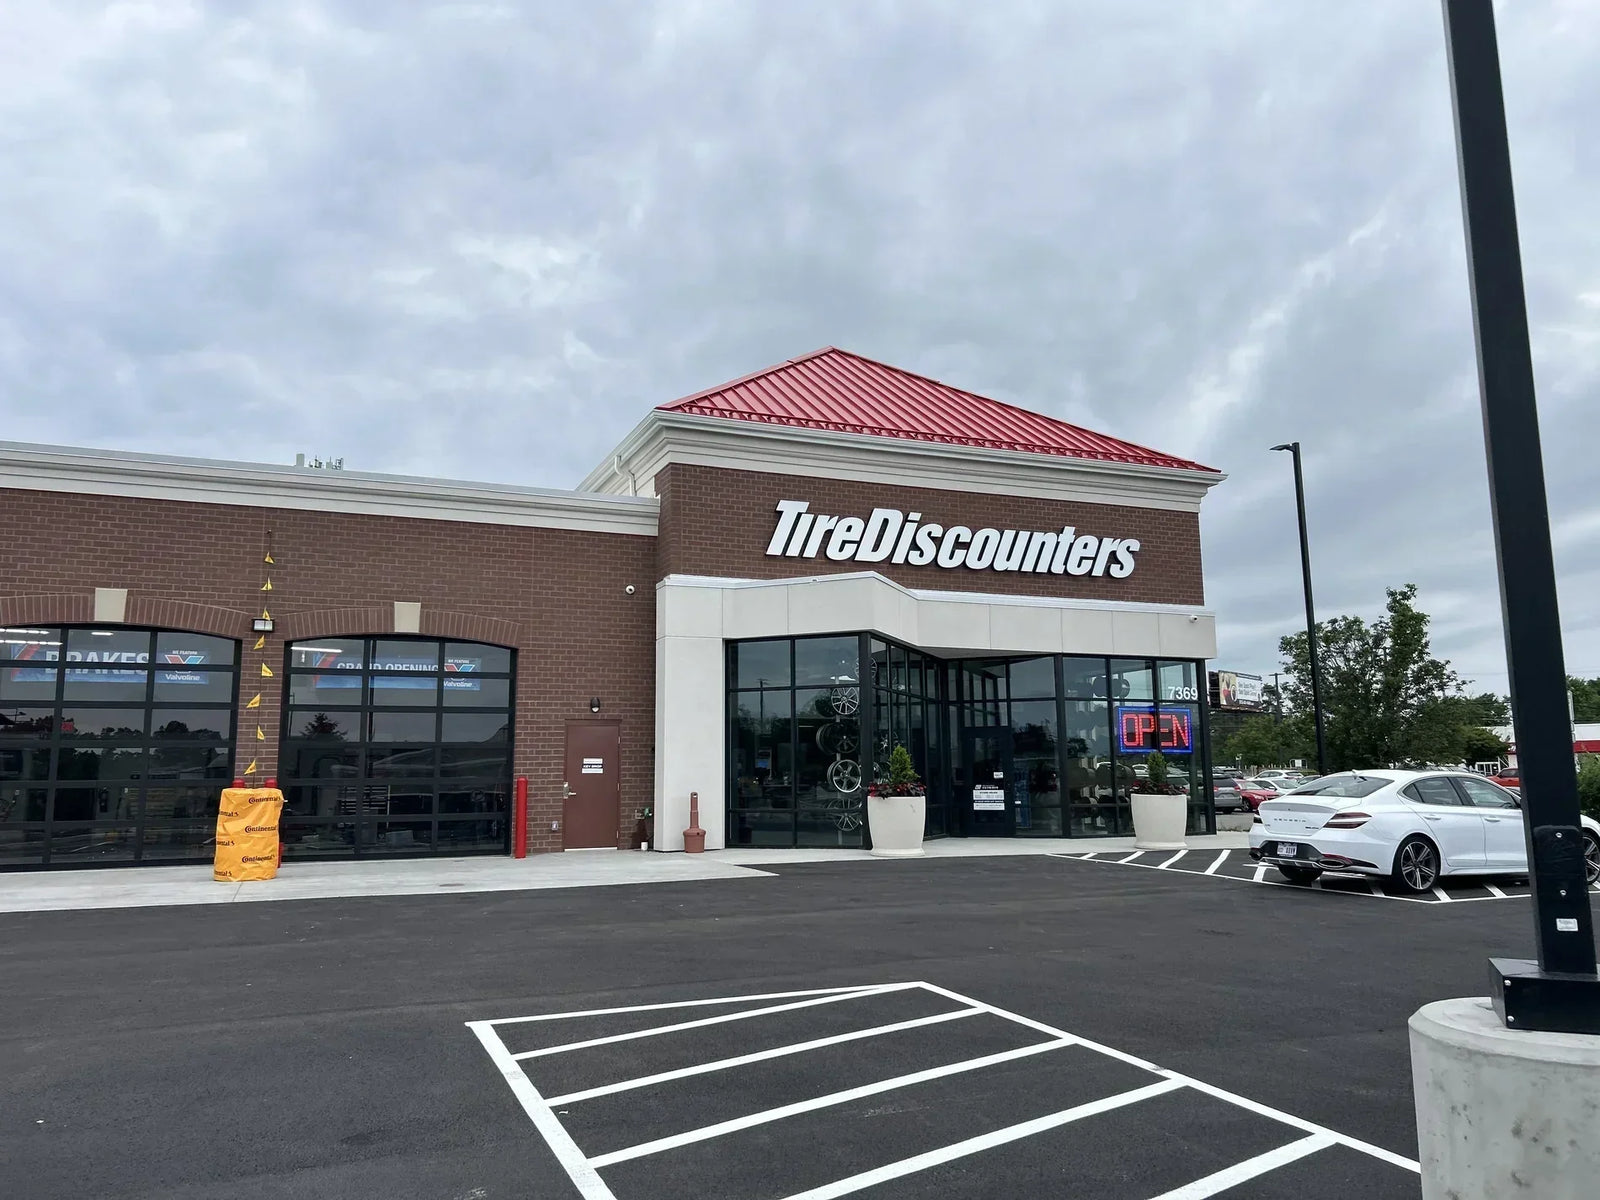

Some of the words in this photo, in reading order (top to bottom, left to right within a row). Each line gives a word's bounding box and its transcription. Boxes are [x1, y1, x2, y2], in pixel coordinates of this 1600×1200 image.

[766, 500, 1140, 579] TireDiscounters
[45, 650, 149, 675] BRAKES
[165, 673, 200, 681] Valvoline
[1167, 686, 1198, 700] 7369
[1122, 713, 1189, 747] OPEN
